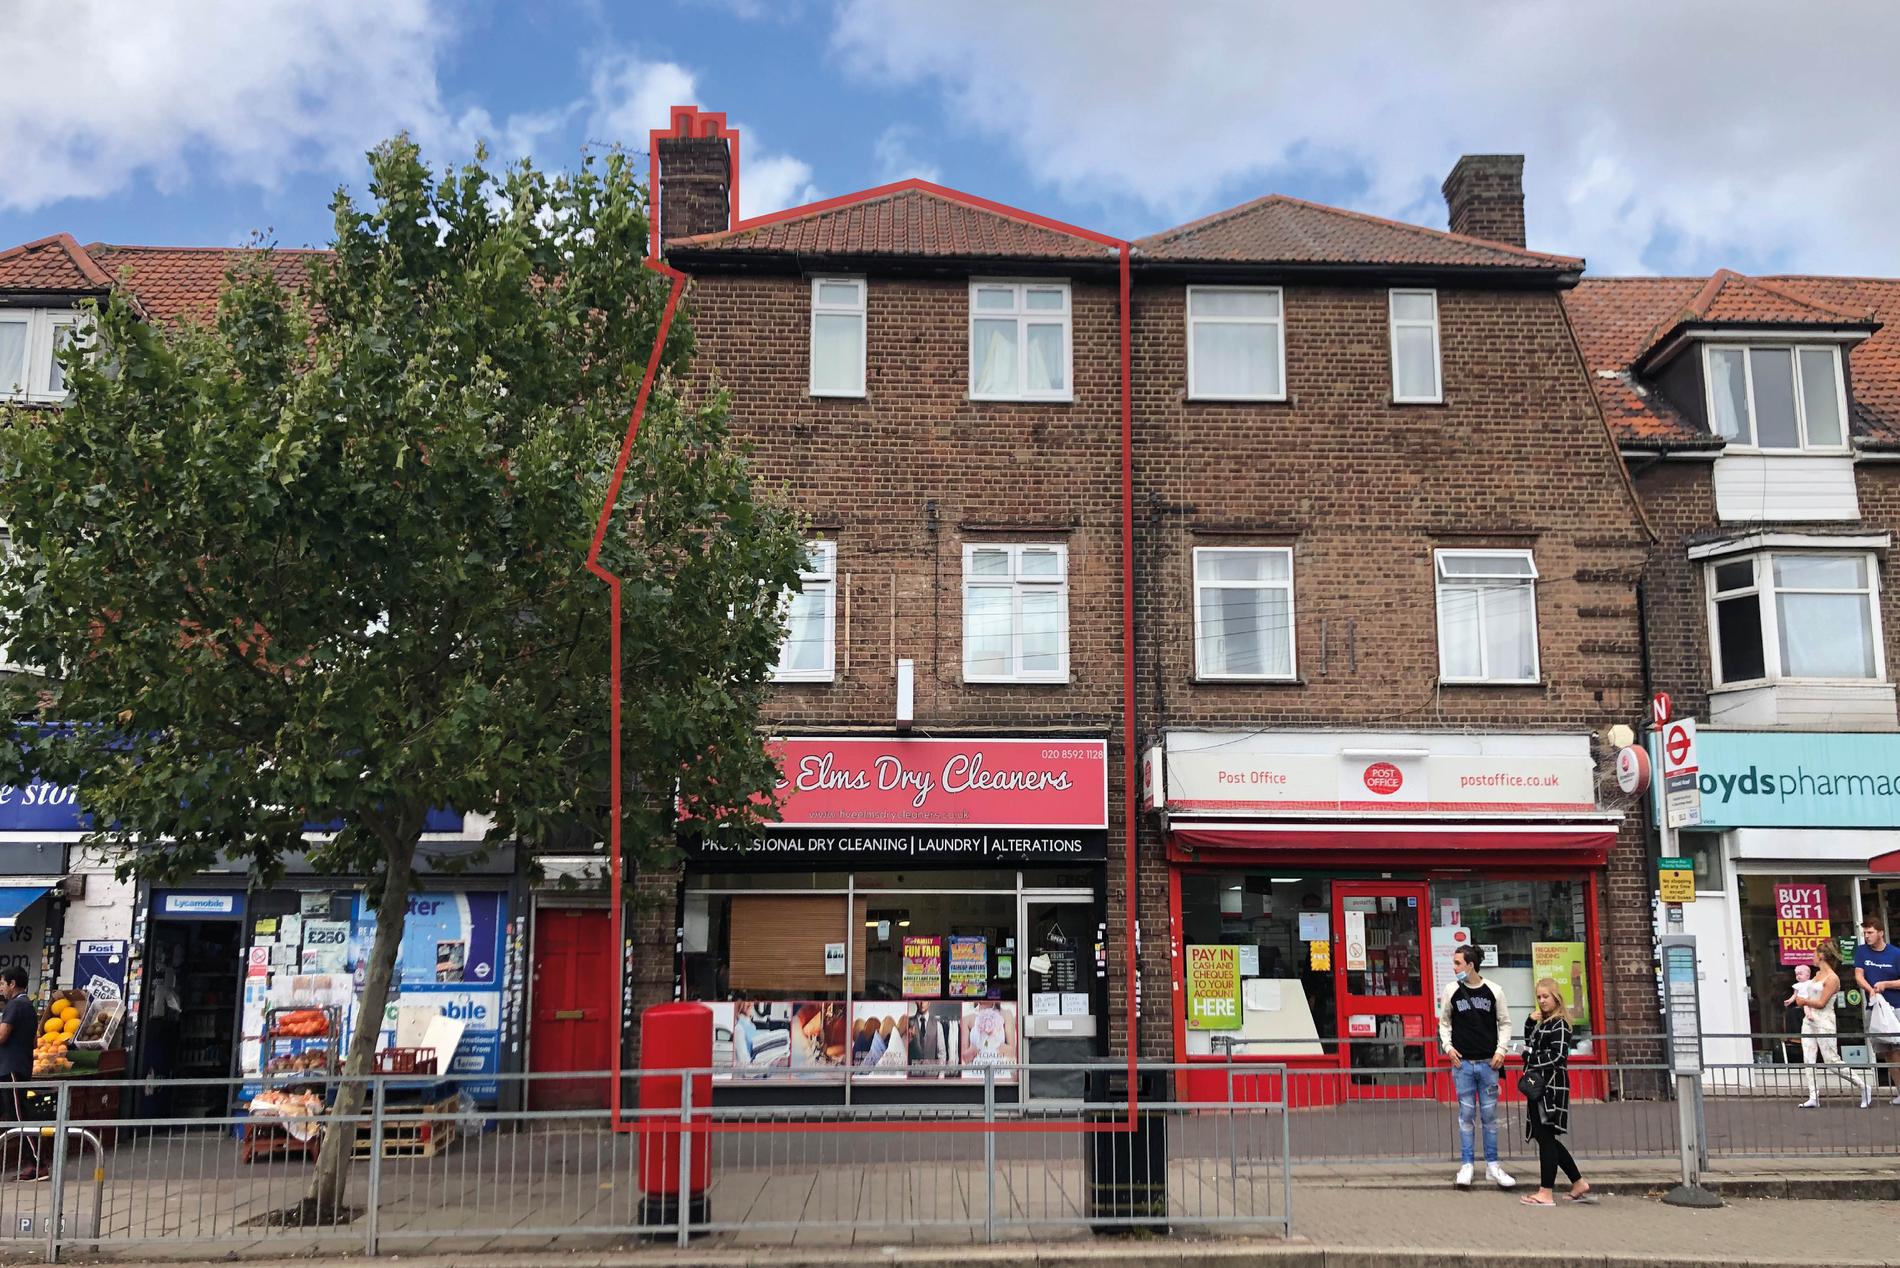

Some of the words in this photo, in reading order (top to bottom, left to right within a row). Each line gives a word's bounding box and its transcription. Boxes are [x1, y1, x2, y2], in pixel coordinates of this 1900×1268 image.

[1653, 697, 1667, 721] N
[1041, 750, 1059, 759] 020
[1061, 750, 1084, 759] 8592
[1086, 750, 1103, 760] 1128
[796, 751, 871, 792] Elms
[873, 753, 935, 808] Dry
[941, 751, 1073, 793] Cleaners
[1218, 771, 1245, 784] Post
[1250, 771, 1287, 784] Office
[1372, 769, 1395, 778] POST
[1367, 778, 1398, 787] OFFICE
[1460, 773, 1559, 788] postoffice.co.uk
[1699, 765, 1900, 804] oydspharma
[21, 782, 80, 806] stor
[808, 838, 835, 851] DRY
[838, 838, 907, 851] CLEANING
[918, 838, 981, 852] LAUNDRY
[991, 839, 1082, 852] ALTERATIONS
[1779, 889, 1811, 904] BUY
[1813, 889, 1821, 903] 1
[174, 899, 224, 909] Lycamobile
[1781, 904, 1812, 919] GET
[1814, 904, 1822, 919] 1
[1782, 920, 1824, 936] HALF
[307, 931, 346, 945] £250
[914, 937, 933, 945] FAMILY
[1783, 937, 1824, 951] PRICE
[88, 944, 114, 952] Post
[904, 945, 921, 958] FUN
[922, 945, 940, 958] FAIR
[1192, 949, 1217, 961] PAY
[1220, 949, 1233, 961] IN
[1193, 962, 1214, 970] CASH
[1216, 962, 1234, 970] AND
[1193, 970, 1234, 979] CHEQUES
[1194, 980, 1207, 989] TO
[1209, 980, 1234, 989] YOUR
[1194, 989, 1234, 998] ACCOUNT
[1193, 997, 1236, 1017] HERE
[20, 1218, 32, 1233] P
